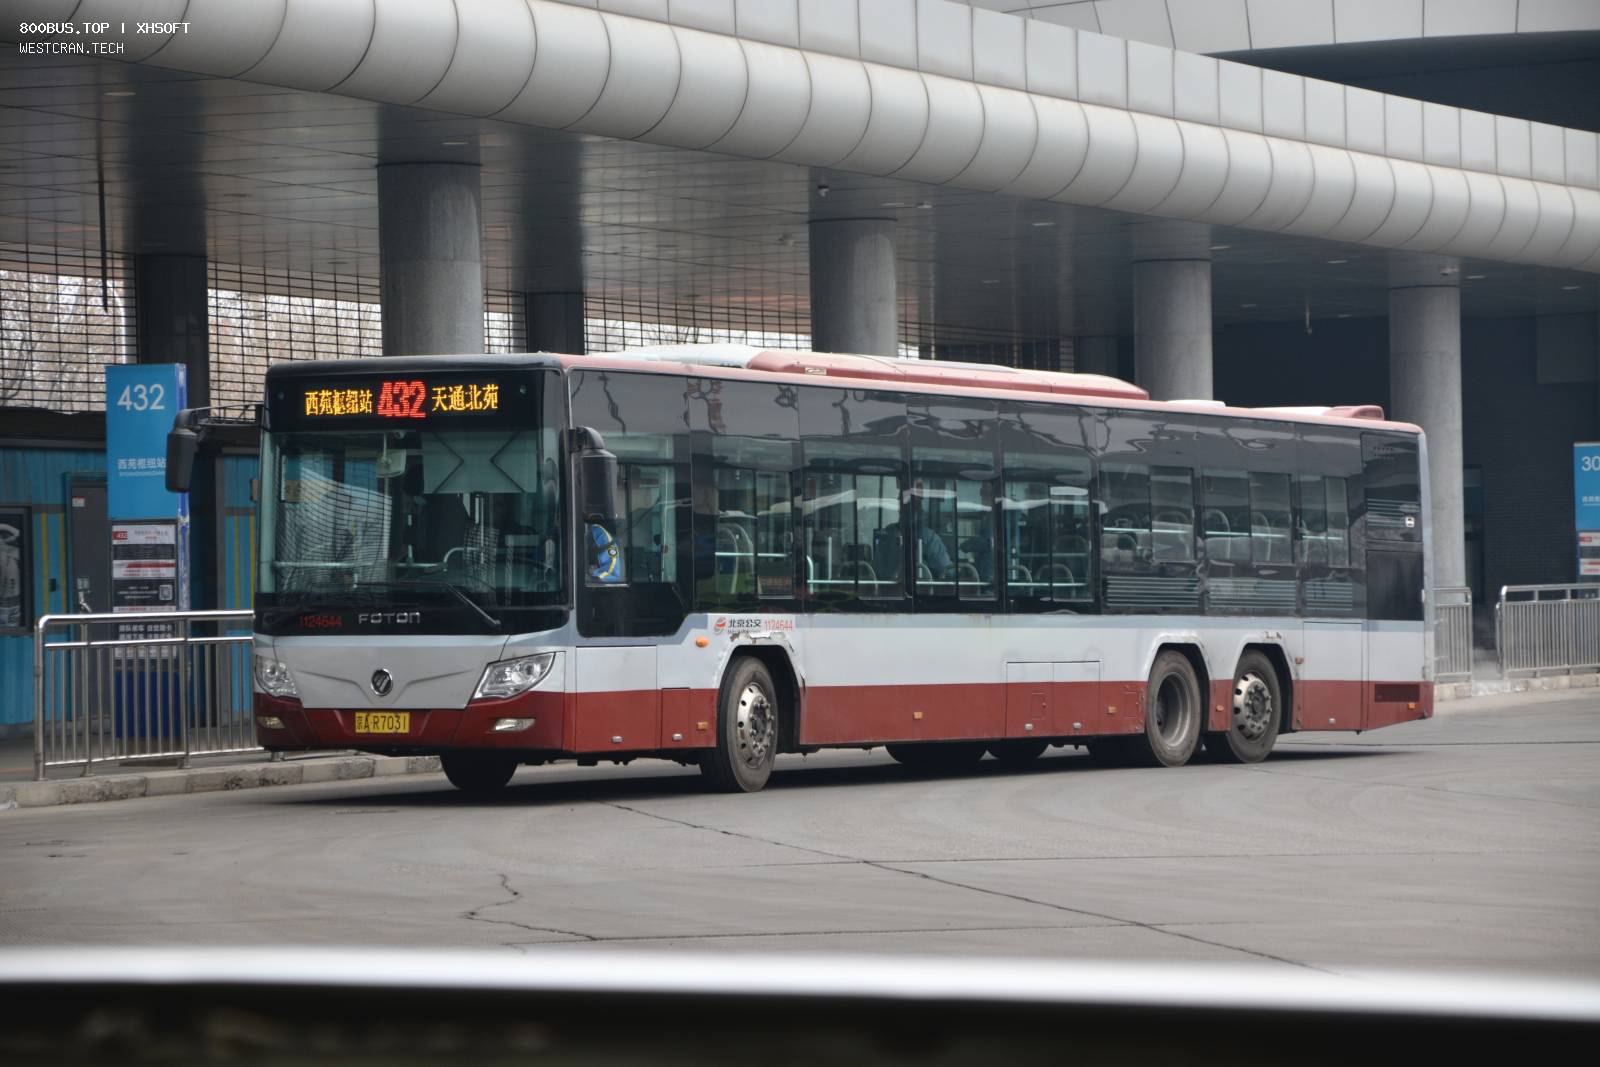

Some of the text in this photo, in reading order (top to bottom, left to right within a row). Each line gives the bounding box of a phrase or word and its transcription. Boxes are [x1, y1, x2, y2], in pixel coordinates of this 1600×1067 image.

[117, 384, 165, 411] 432
[377, 381, 427, 418] 432
[431, 384, 499, 412] 天通北苑
[299, 614, 342, 628] 1124644
[358, 612, 420, 624] FOTON
[728, 618, 793, 631] 北京公交 1124644
